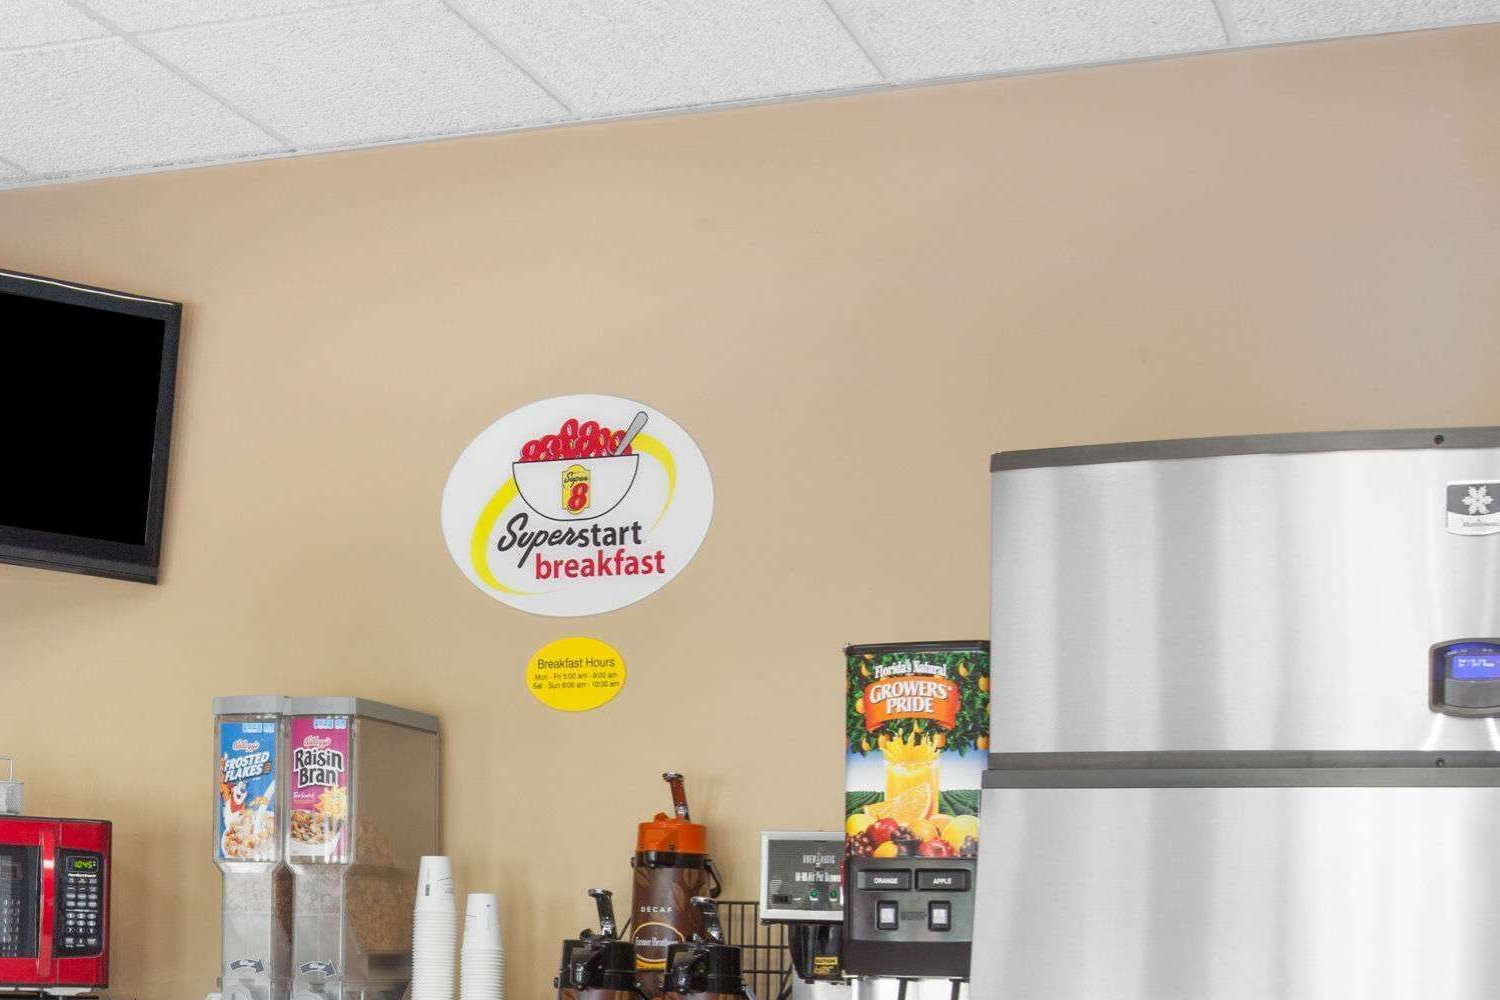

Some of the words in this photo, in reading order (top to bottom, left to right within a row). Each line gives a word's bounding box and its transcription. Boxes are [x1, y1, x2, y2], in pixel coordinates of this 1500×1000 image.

[563, 471, 588, 488] Super
[567, 482, 589, 511] 8
[497, 512, 642, 569] Superstart
[535, 548, 665, 580] breakfast
[537, 657, 582, 670] Breakfast
[585, 657, 616, 668] Hours
[874, 659, 912, 678] Florida's
[913, 660, 948, 678] Natural
[869, 680, 949, 704] GROWERS
[885, 697, 934, 715] PRIDE
[224, 751, 270, 771] FROSTED
[294, 749, 342, 770] Raisin
[224, 764, 263, 782] FLAKES
[299, 767, 337, 787] Bran
[933, 877, 953, 885] APPLE
